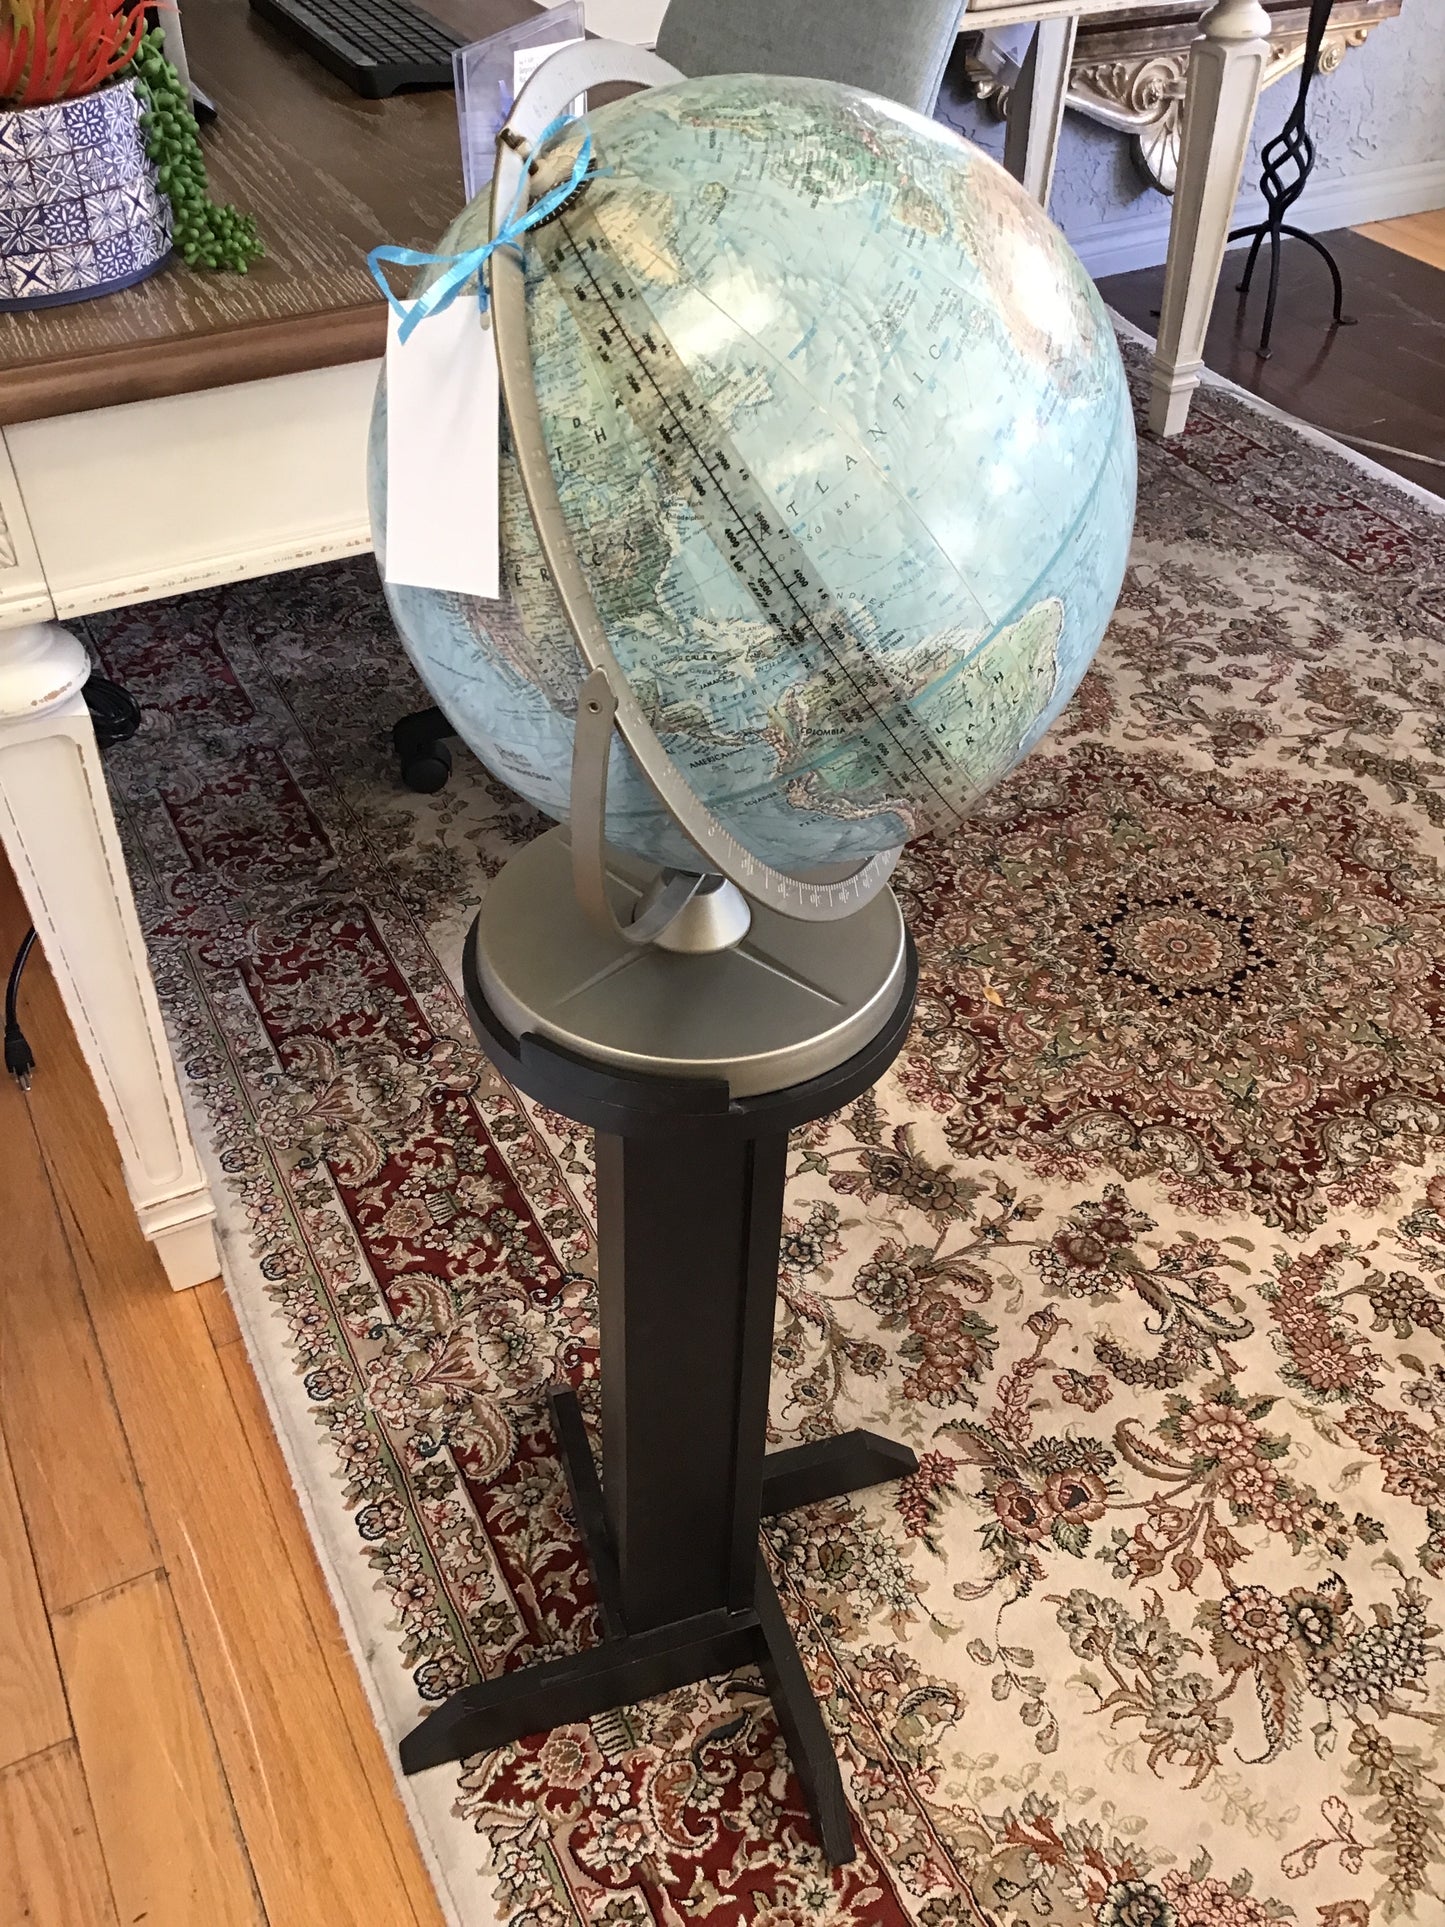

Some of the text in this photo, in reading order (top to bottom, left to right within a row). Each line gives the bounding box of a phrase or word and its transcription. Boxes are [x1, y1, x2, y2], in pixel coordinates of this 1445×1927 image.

[759, 344, 942, 542] ATLANTIC
[836, 493, 860, 516] SEA
[690, 476, 706, 496] 3500
[724, 528, 740, 548] 4000
[757, 577, 773, 596] 4500
[715, 450, 730, 470] 3000
[754, 512, 770, 532] 3500
[793, 568, 808, 588] 4000
[830, 622, 846, 640] 4500
[864, 670, 878, 688] 5000
[748, 581, 770, 608] EARTH
[695, 672, 790, 703] CARIBBEAN
[890, 668, 914, 686] GUYANA
[800, 727, 846, 736] COLOMBIA
[689, 751, 728, 769] AMERICA
